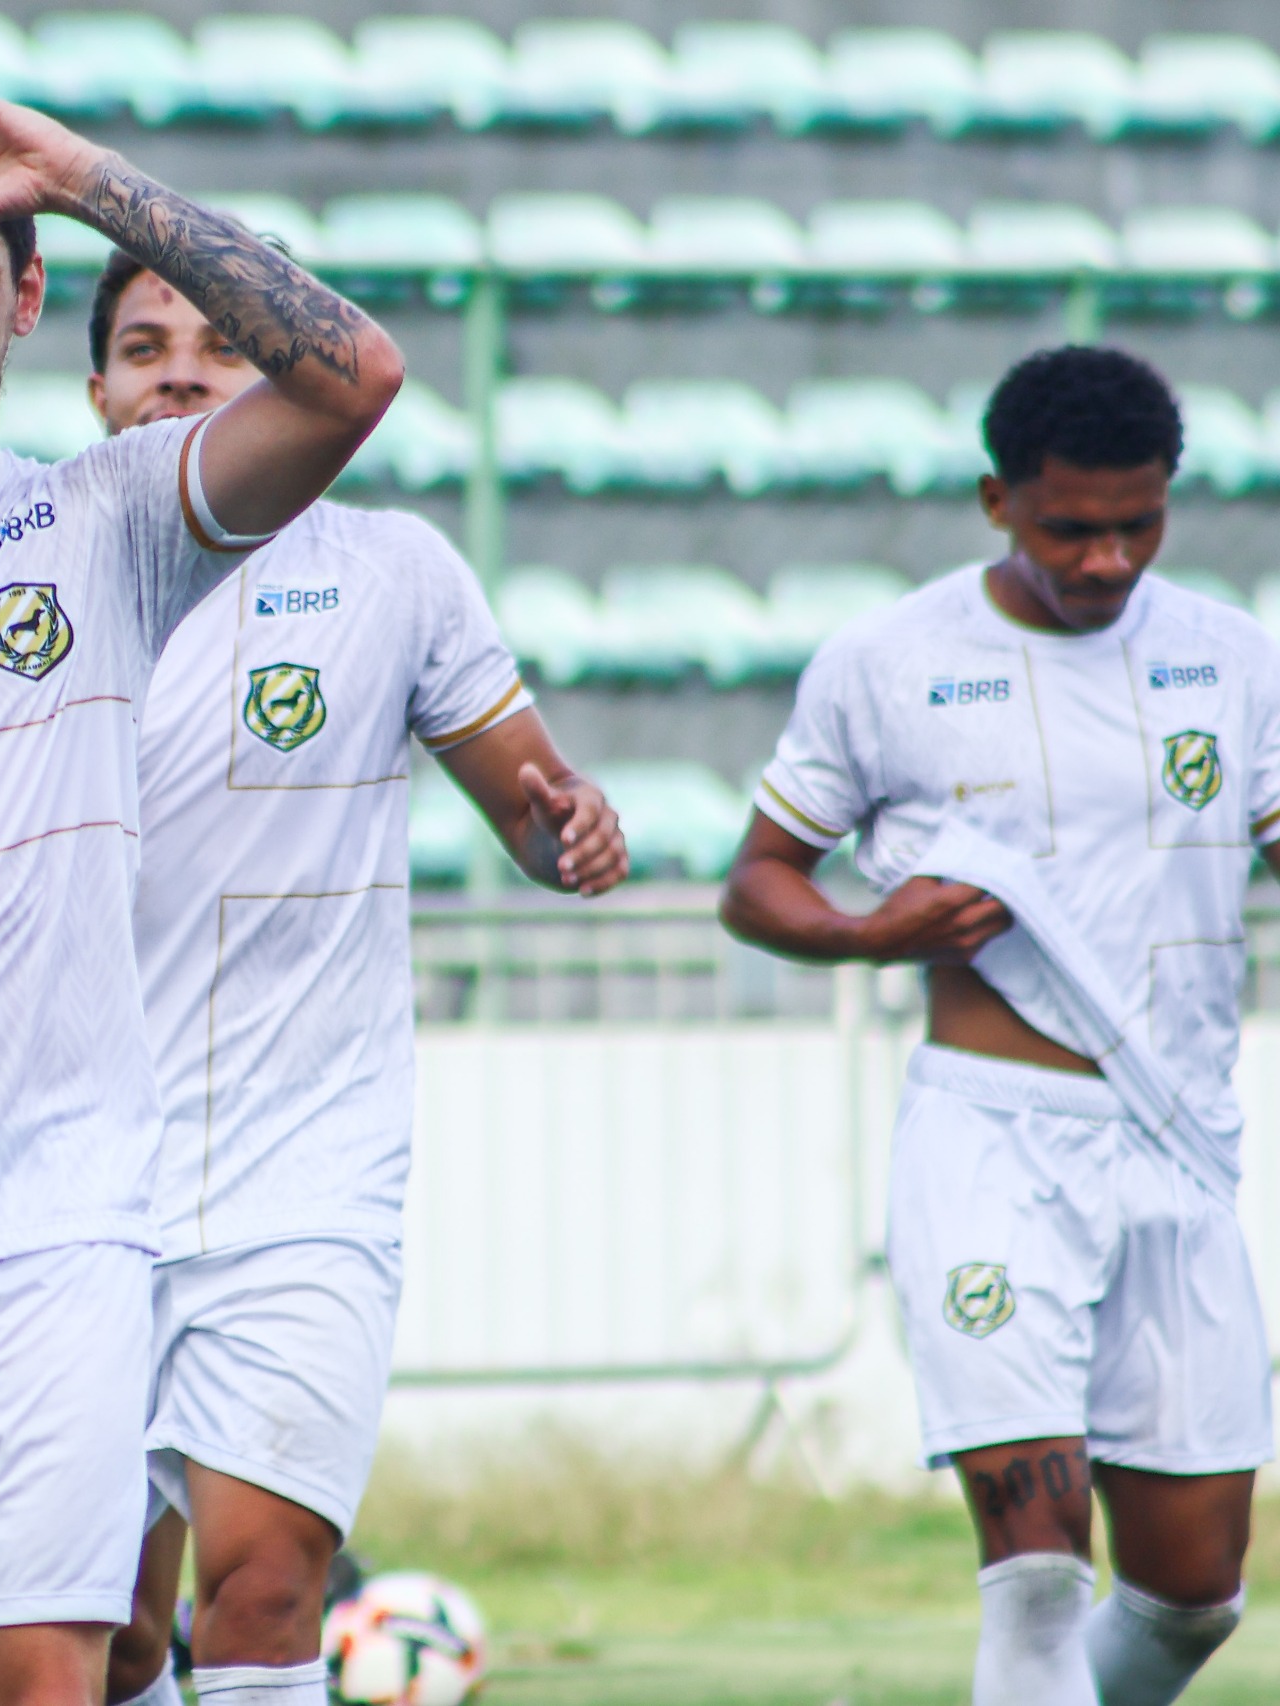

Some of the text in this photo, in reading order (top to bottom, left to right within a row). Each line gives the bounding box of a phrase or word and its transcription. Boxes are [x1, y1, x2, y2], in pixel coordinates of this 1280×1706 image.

[286, 587, 339, 614] BRB
[1171, 665, 1218, 689] BRB
[957, 679, 1010, 705] BRB
